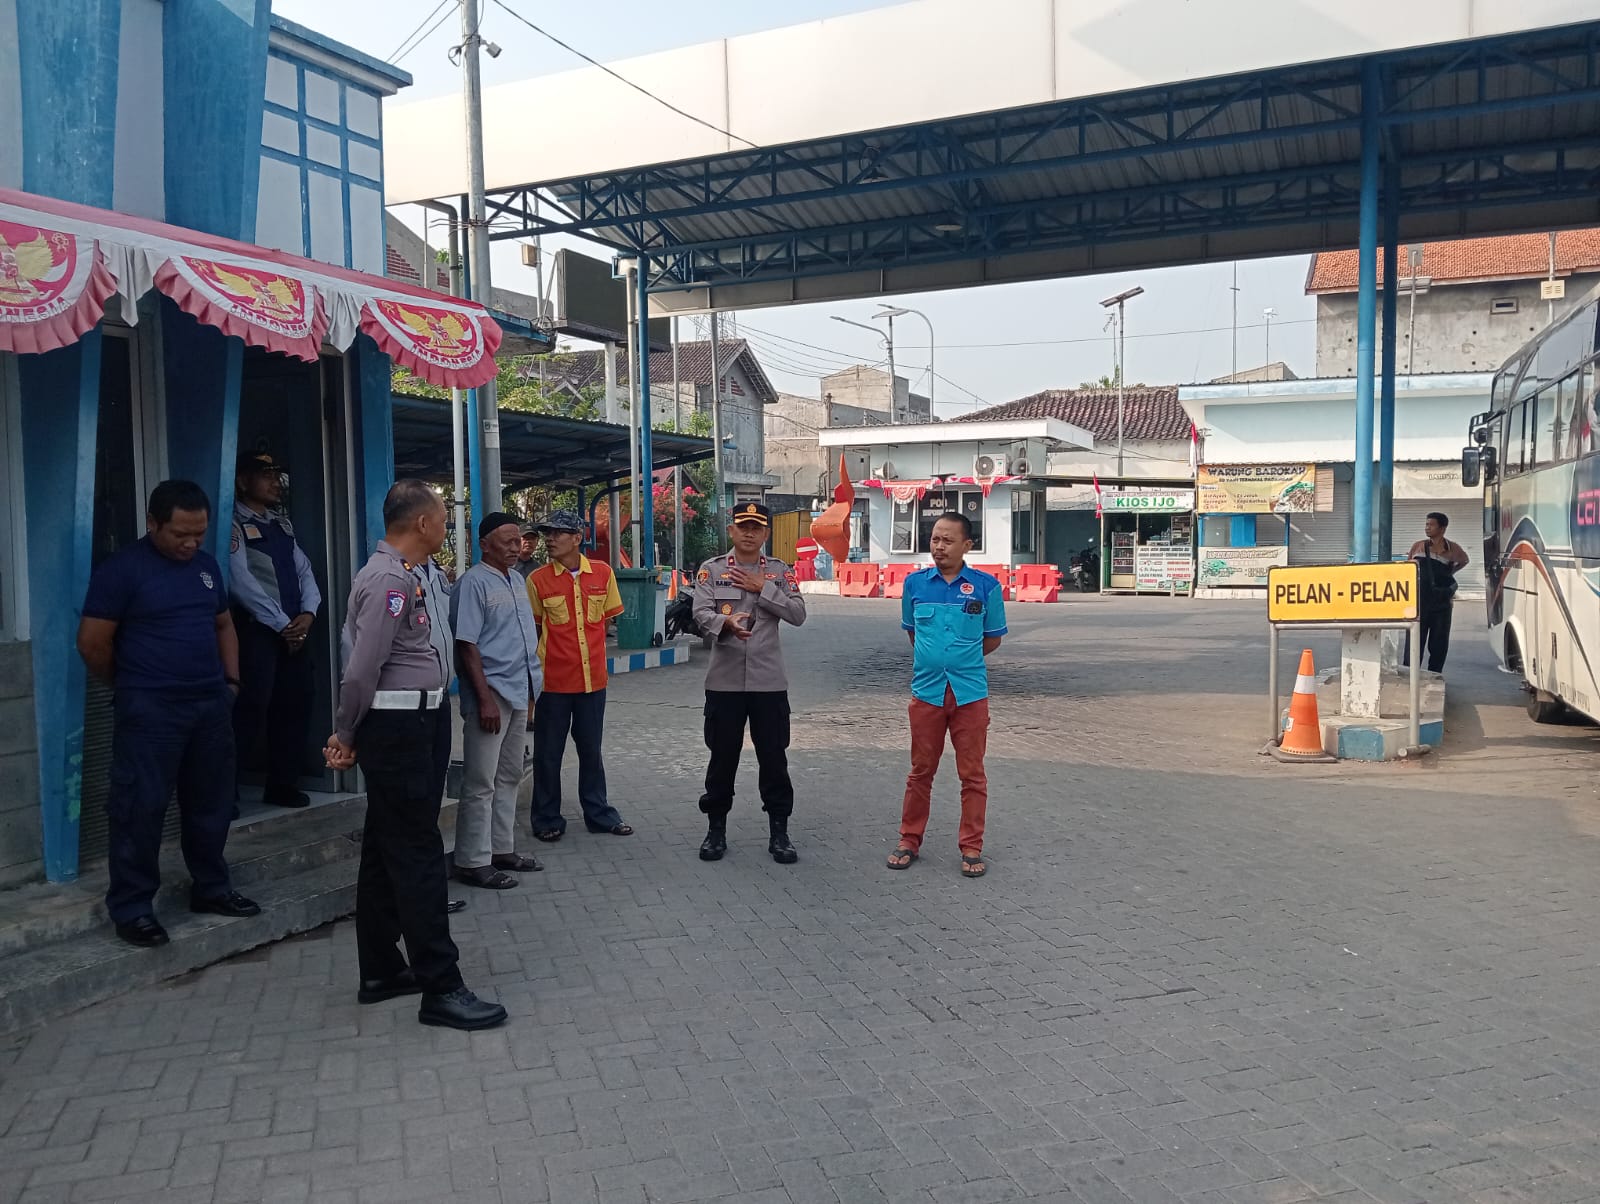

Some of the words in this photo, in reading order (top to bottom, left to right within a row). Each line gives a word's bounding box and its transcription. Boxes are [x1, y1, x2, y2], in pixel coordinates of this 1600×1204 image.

[0, 296, 70, 321] NESIA
[411, 343, 481, 369] INDONESIA
[1208, 467, 1253, 476] WARUNG
[1116, 497, 1149, 507] KIOS
[1153, 497, 1175, 507] IJO
[1275, 583, 1331, 604] PELAN
[1350, 581, 1409, 603] PELAN
